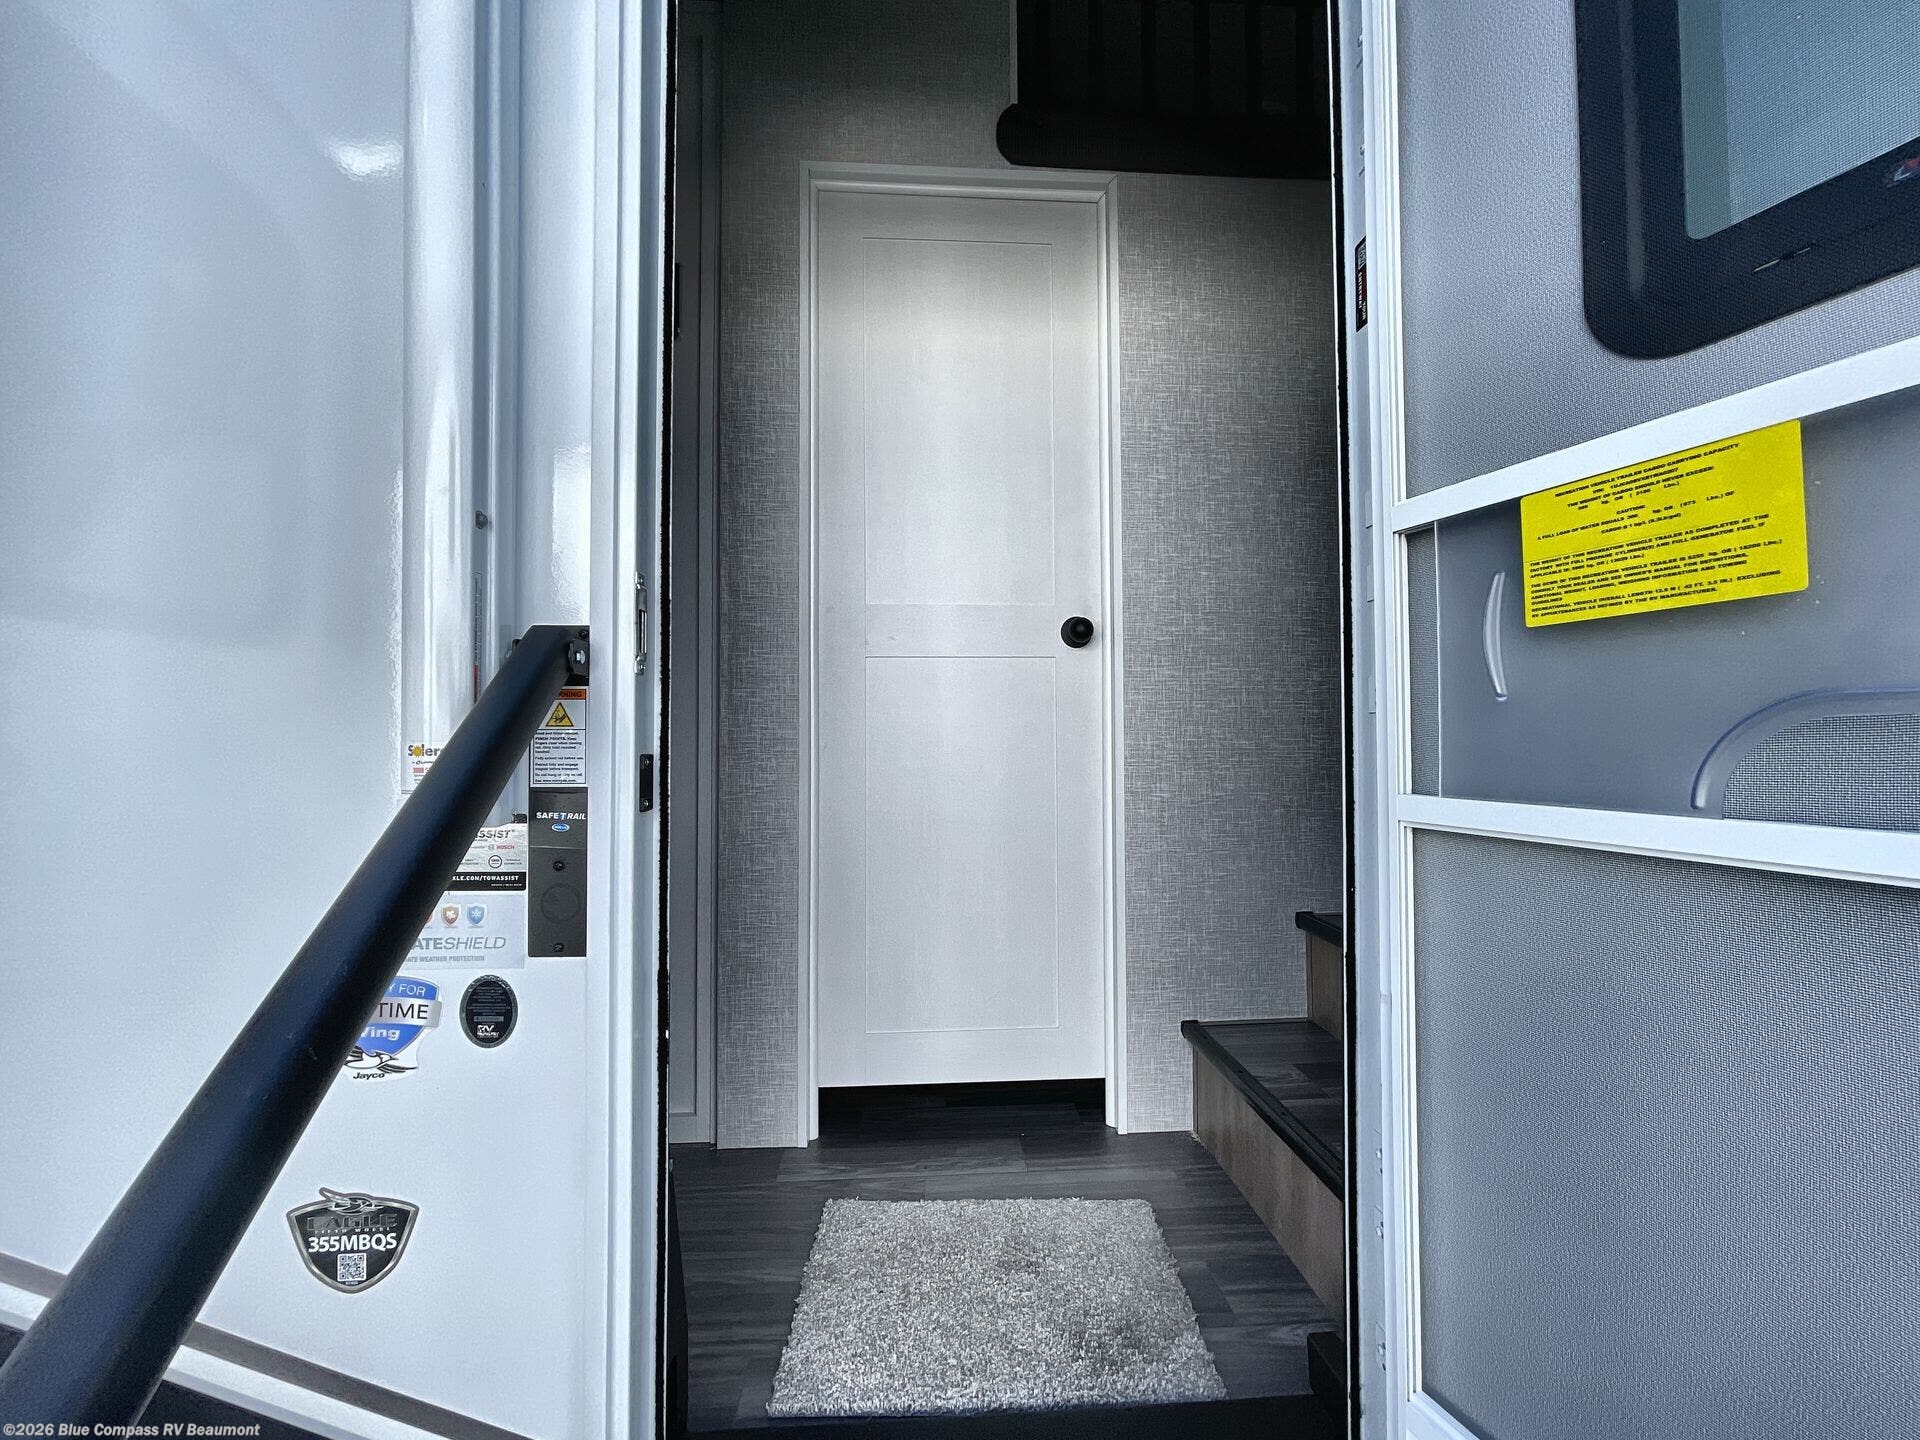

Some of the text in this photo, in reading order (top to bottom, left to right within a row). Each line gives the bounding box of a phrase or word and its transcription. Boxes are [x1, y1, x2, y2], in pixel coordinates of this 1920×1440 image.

[1554, 442, 1739, 498] RECREATION VEHICLE TRAILER CARGO CARRYING CAPACITY
[1579, 494, 1601, 505] WEIGHT
[1611, 486, 1633, 496] CARGO
[1634, 479, 1660, 490] SHOULD
[1661, 472, 1684, 483] NEVER
[1616, 503, 1645, 515] CAUTION:
[1600, 525, 1621, 534] CARGO
[1541, 556, 1562, 565] WEIGHT
[1586, 543, 1624, 555] RECREATION
[1625, 537, 1652, 547] VEHICLE
[1654, 531, 1682, 541] TRAILER
[1695, 519, 1739, 533] COMPLETED
[1753, 513, 1769, 521] THE
[1529, 564, 1553, 573] FACTORY
[1585, 552, 1612, 562] PROPANE
[1671, 537, 1689, 545] FULL
[1690, 528, 1734, 541] GENERATOR
[1736, 523, 1756, 532] FUEL
[1529, 568, 1562, 579] APPLICABLE
[1581, 568, 1619, 579] RECREATION
[1620, 563, 1647, 572] VEHICLE
[1649, 557, 1677, 567] TRAILER
[1530, 586, 1555, 594] CONSULT
[1653, 563, 1681, 572] MANUAL
[1530, 590, 1562, 600] ADDITIONAL
[1617, 575, 1650, 585] WEIGHING
[1651, 567, 1698, 580] INFORMATION
[1717, 559, 1747, 569] TOWING
[1531, 602, 1571, 612] RECREATIONAL
[1598, 594, 1626, 602] OVERALL
[1736, 569, 1781, 581] EXCLUDING
[1540, 606, 1586, 617] APPURTENANCES
[1596, 600, 1623, 608] DEFINED
[408, 744, 441, 757] Soler
[476, 830, 511, 838] SSIST
[413, 937, 506, 950] ATESHIELD
[399, 984, 426, 996] FOR
[361, 1026, 400, 1040] ing
[353, 1072, 385, 1080] Jayco
[307, 1214, 397, 1230] EAGLE
[309, 1233, 397, 1252] 355MBQS
